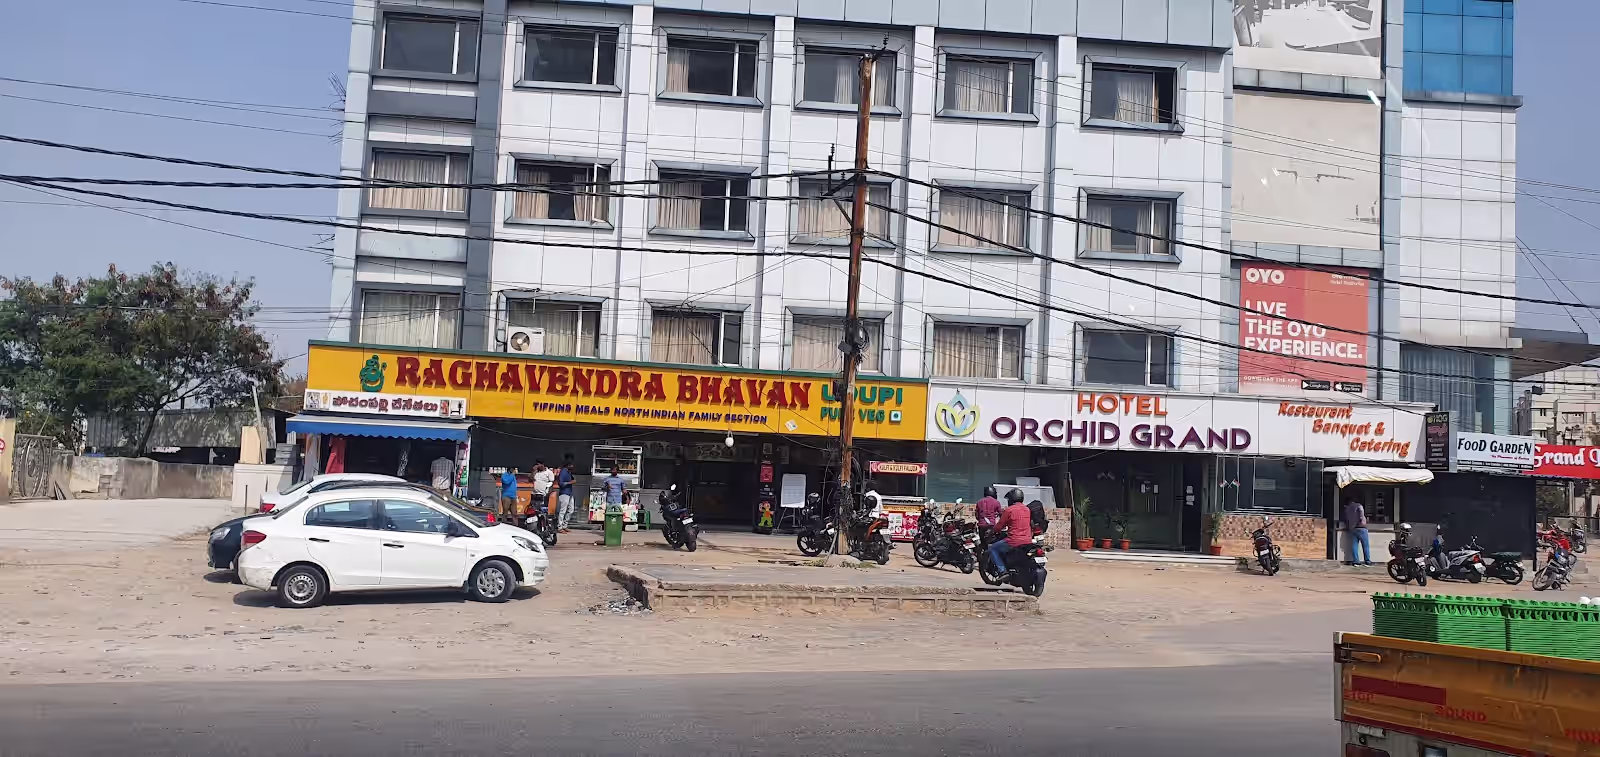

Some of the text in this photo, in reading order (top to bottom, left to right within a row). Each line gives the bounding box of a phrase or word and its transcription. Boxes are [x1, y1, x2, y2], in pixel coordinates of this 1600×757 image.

[1246, 268, 1285, 285] OYO
[1245, 300, 1287, 318] LIVE
[1245, 318, 1327, 338] THE OYO
[1245, 337, 1363, 359] EXPERIENCE.
[394, 356, 812, 411] RAGHAVENDRA BHAVAN
[821, 383, 903, 406] UUPI
[1077, 392, 1168, 417] HOTEL
[575, 404, 610, 416] MEALS
[688, 411, 723, 423] FAMILY
[725, 413, 768, 425] SECTION
[859, 409, 886, 424] VEG
[1277, 400, 1353, 419] Restaurant
[989, 416, 1252, 451] ORCHID GRAND
[1312, 418, 1385, 439] Banquet &
[1349, 436, 1411, 458] Catering
